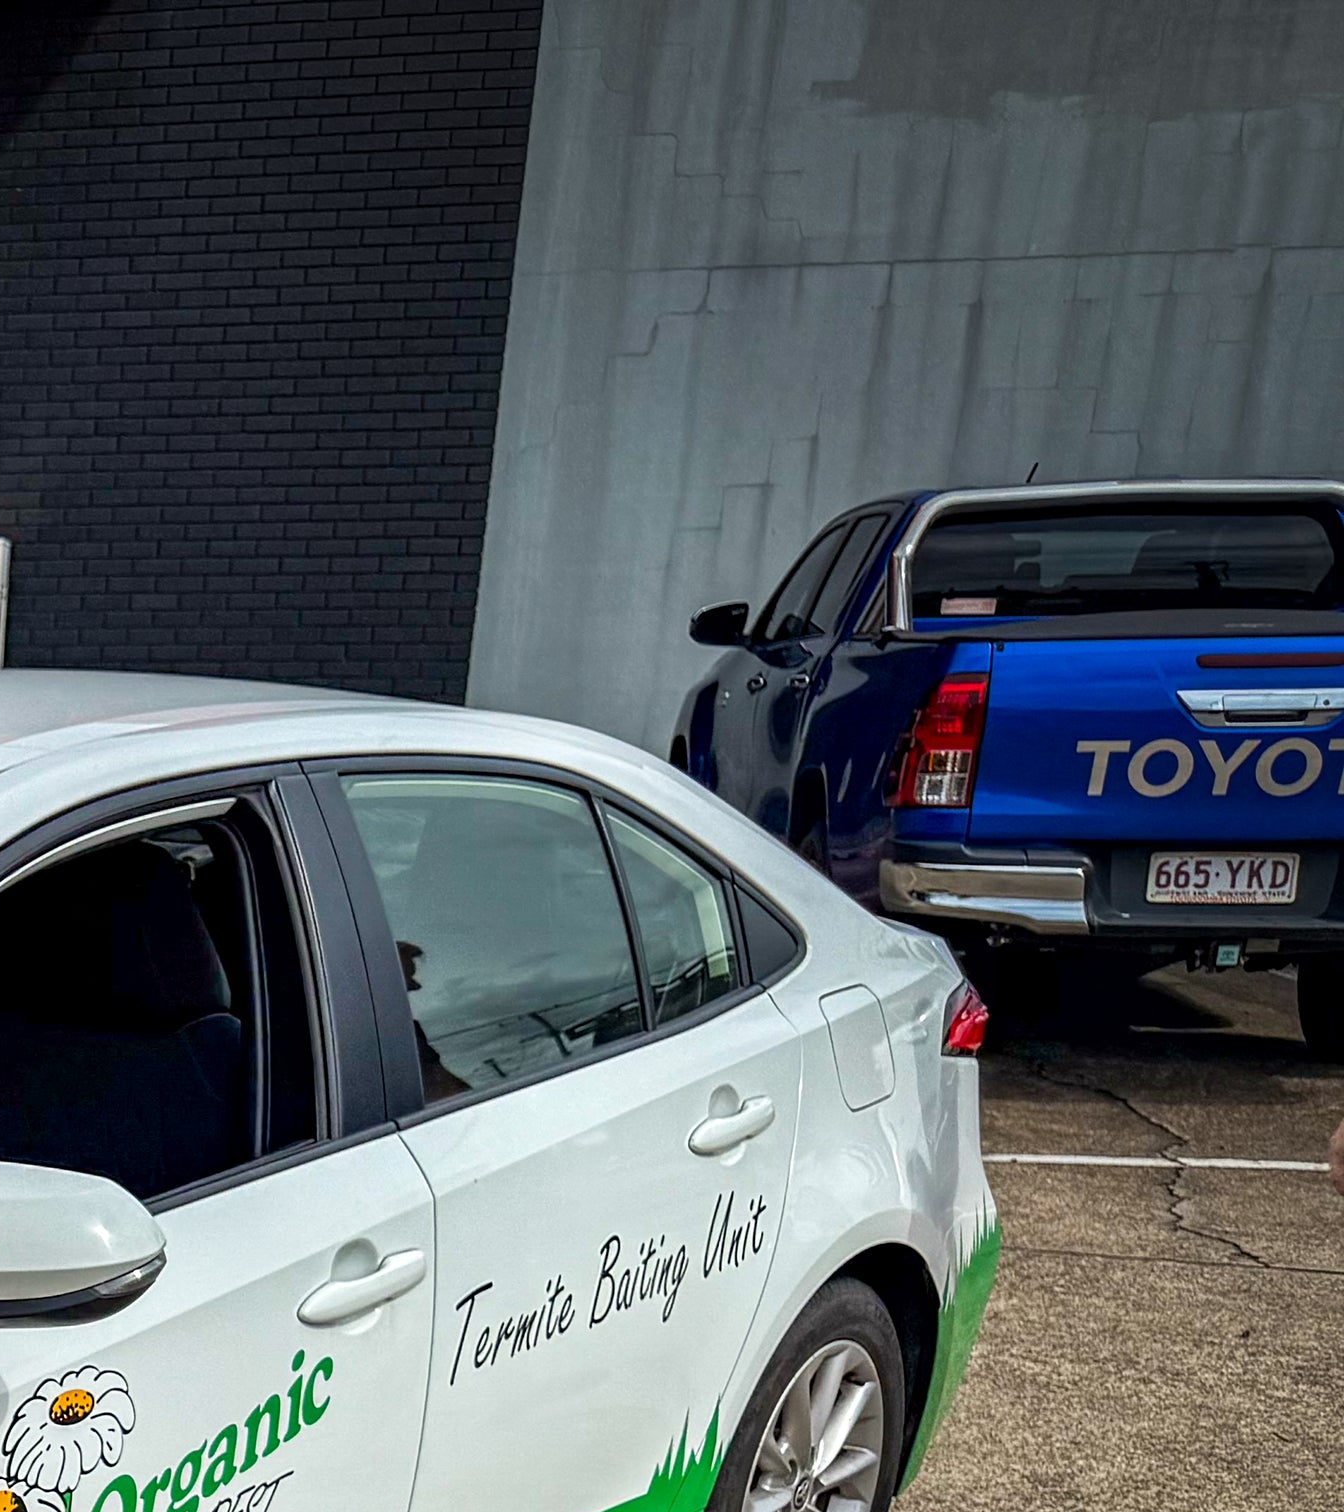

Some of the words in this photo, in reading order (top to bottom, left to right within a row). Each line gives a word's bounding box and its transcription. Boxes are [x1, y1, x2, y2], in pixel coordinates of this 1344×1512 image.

[449, 1275, 576, 1386] Termite
[588, 1235, 690, 1329] Baiting
[703, 1190, 768, 1279] Unit
